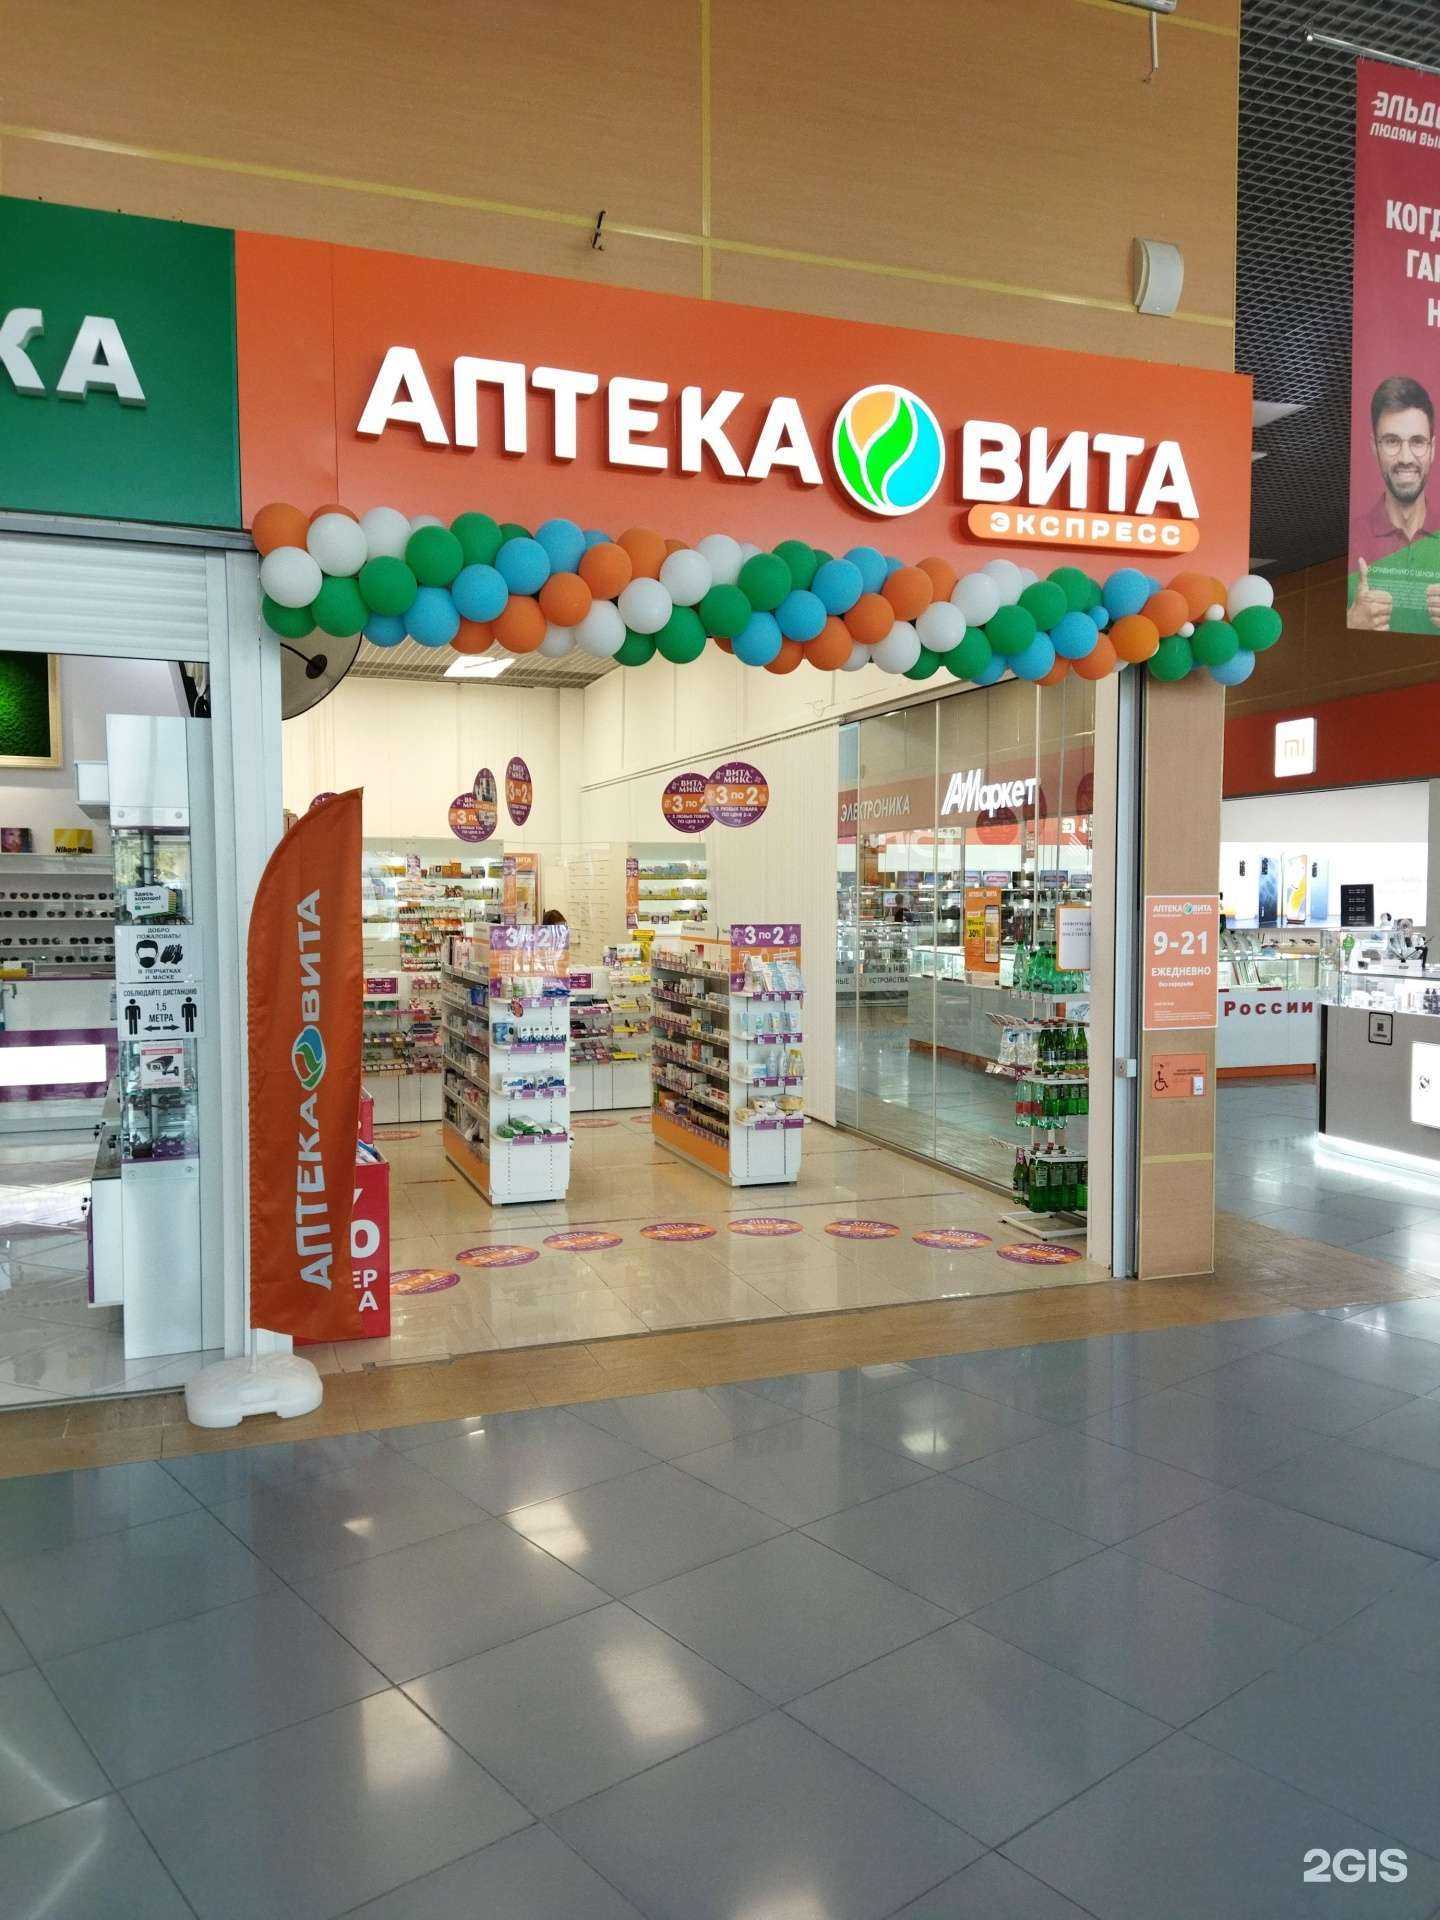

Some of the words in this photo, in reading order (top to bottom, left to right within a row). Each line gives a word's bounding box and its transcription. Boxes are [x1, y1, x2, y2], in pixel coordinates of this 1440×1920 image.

[1370, 122, 1417, 144] ЛЮДЯМ
[1419, 132, 1440, 149] ВЫ
[356, 345, 824, 487] АПТЕКА
[962, 419, 1200, 519] ВИТА
[989, 511, 1181, 546] ЭКСПРЕСС
[725, 769, 750, 777] ВИТА
[521, 784, 528, 803] 2
[716, 786, 728, 804] 3
[746, 787, 759, 805] 2
[940, 768, 1041, 818] АМаркет
[672, 795, 684, 812] 3
[840, 796, 911, 822] ЭЛЕКТРОНИКА
[456, 809, 467, 825] 3
[1153, 904, 1183, 913] АПТЕКА
[505, 926, 519, 947] 3
[538, 927, 552, 948] 2
[744, 925, 757, 945] 3
[758, 931, 772, 940] по
[772, 926, 785, 945] 2
[1153, 931, 1208, 955] 9-21
[296, 888, 322, 1022] ВИТА
[1151, 966, 1212, 978] ЕЖЕДНЕВНО
[123, 989, 161, 998] СОБЛЮДАЙТЕ
[162, 988, 198, 996] ДИСТАНЦИЮ
[156, 1002, 167, 1012] 1,5
[1224, 1001, 1313, 1017] России
[149, 1013, 175, 1023] МЕТРА
[296, 1093, 333, 1290] АПТЕКА
